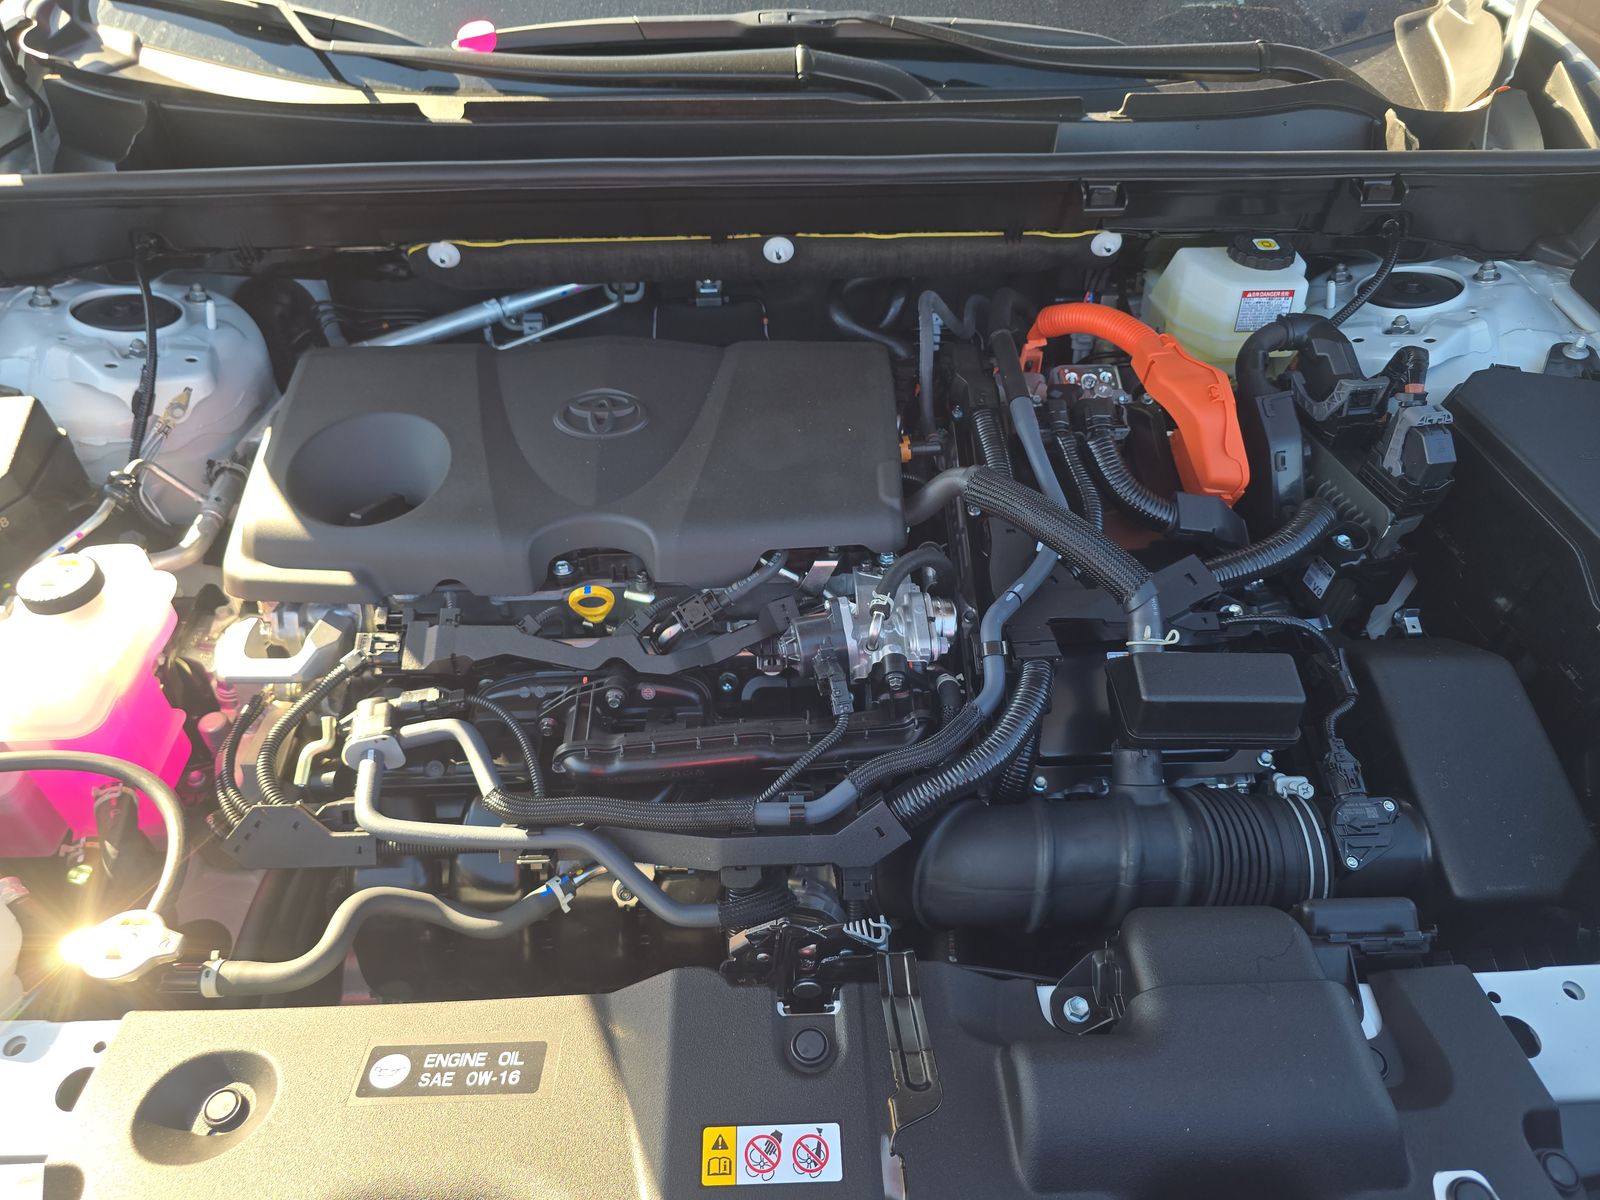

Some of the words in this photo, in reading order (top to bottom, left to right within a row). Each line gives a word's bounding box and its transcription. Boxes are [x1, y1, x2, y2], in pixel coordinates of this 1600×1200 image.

[423, 1052, 488, 1068] ENGINE
[498, 1051, 525, 1066] OIL
[418, 1072, 456, 1087] SAE
[466, 1070, 521, 1086] 0W-16
